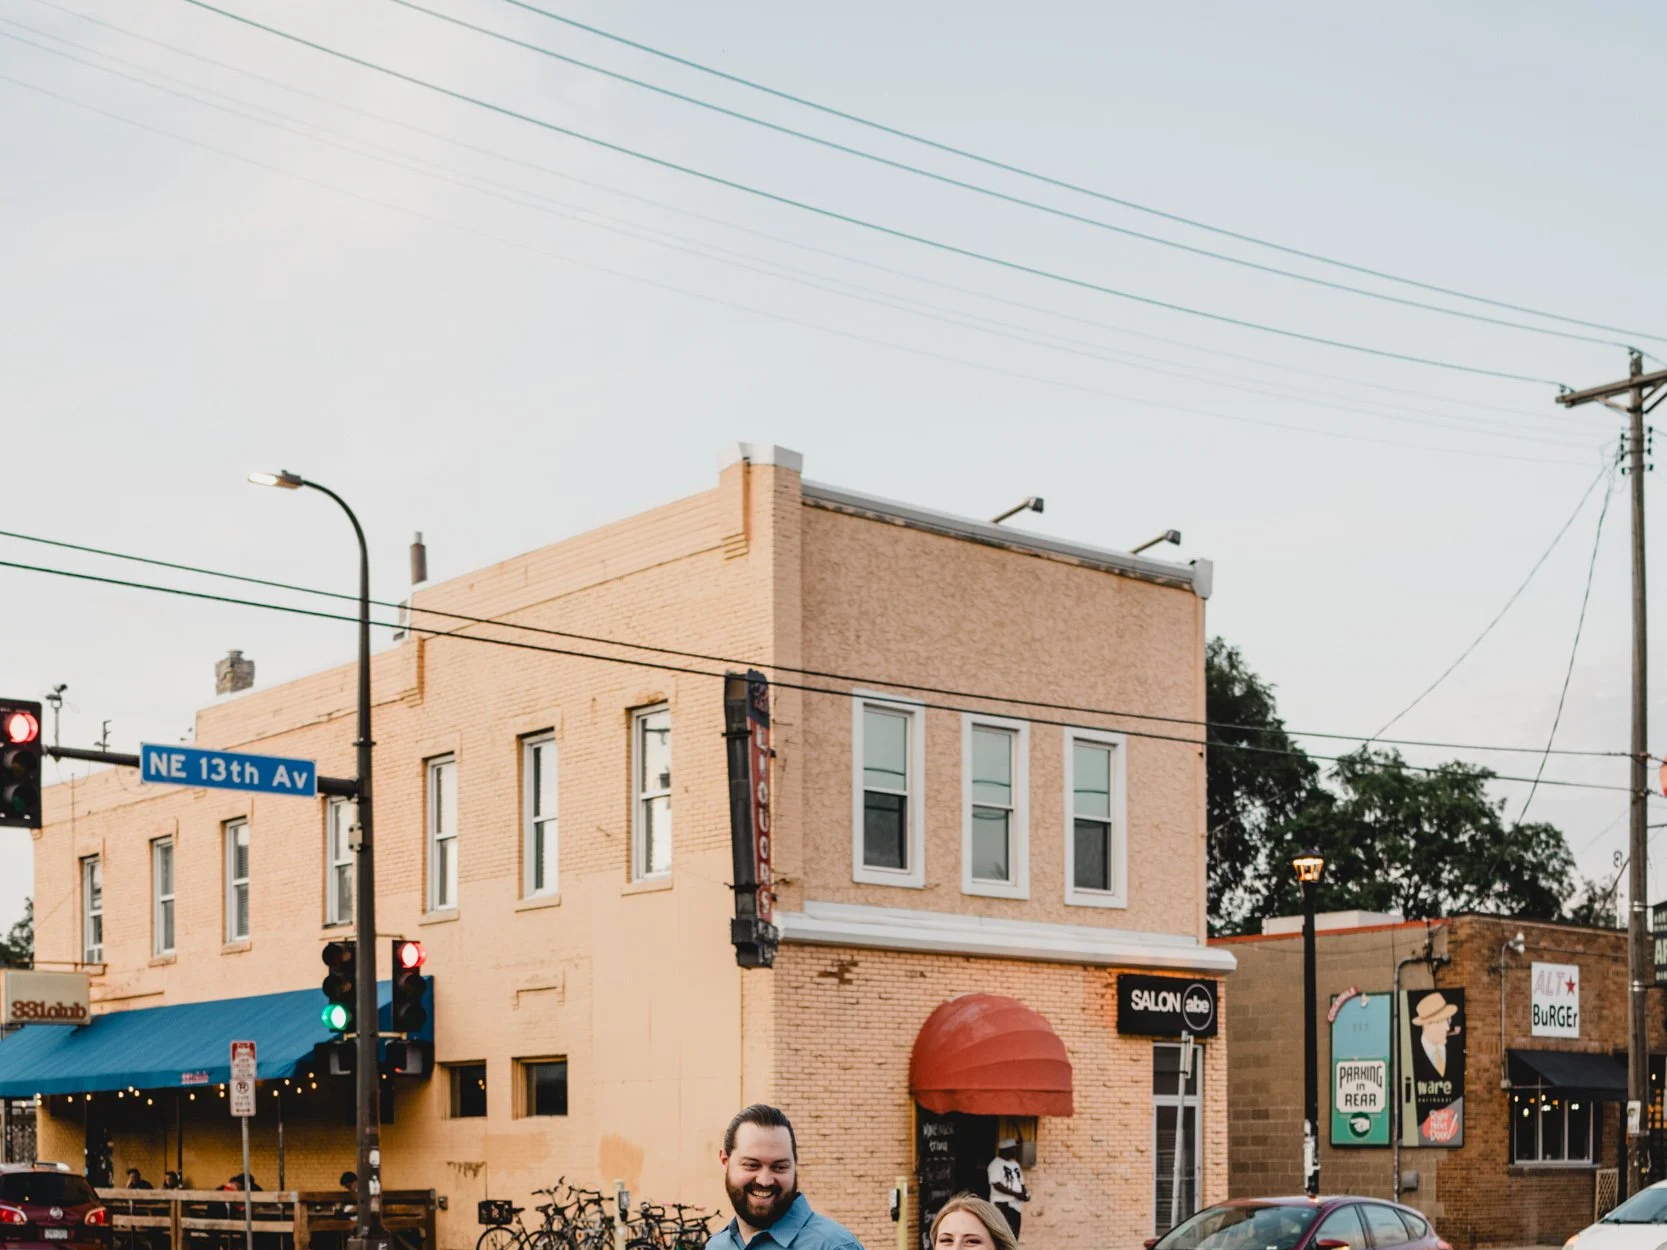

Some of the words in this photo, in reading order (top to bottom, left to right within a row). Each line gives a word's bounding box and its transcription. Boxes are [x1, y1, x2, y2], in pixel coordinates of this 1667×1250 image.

[150, 752, 187, 778] NE
[200, 757, 259, 785] 13th
[271, 765, 308, 789] Av
[1535, 970, 1565, 997] ALT
[1131, 989, 1181, 1013] SALON
[1185, 994, 1210, 1014] abe
[1340, 1065, 1382, 1088] PARKING
[1417, 1081, 1452, 1095] ware
[1345, 1093, 1376, 1107] REAR
